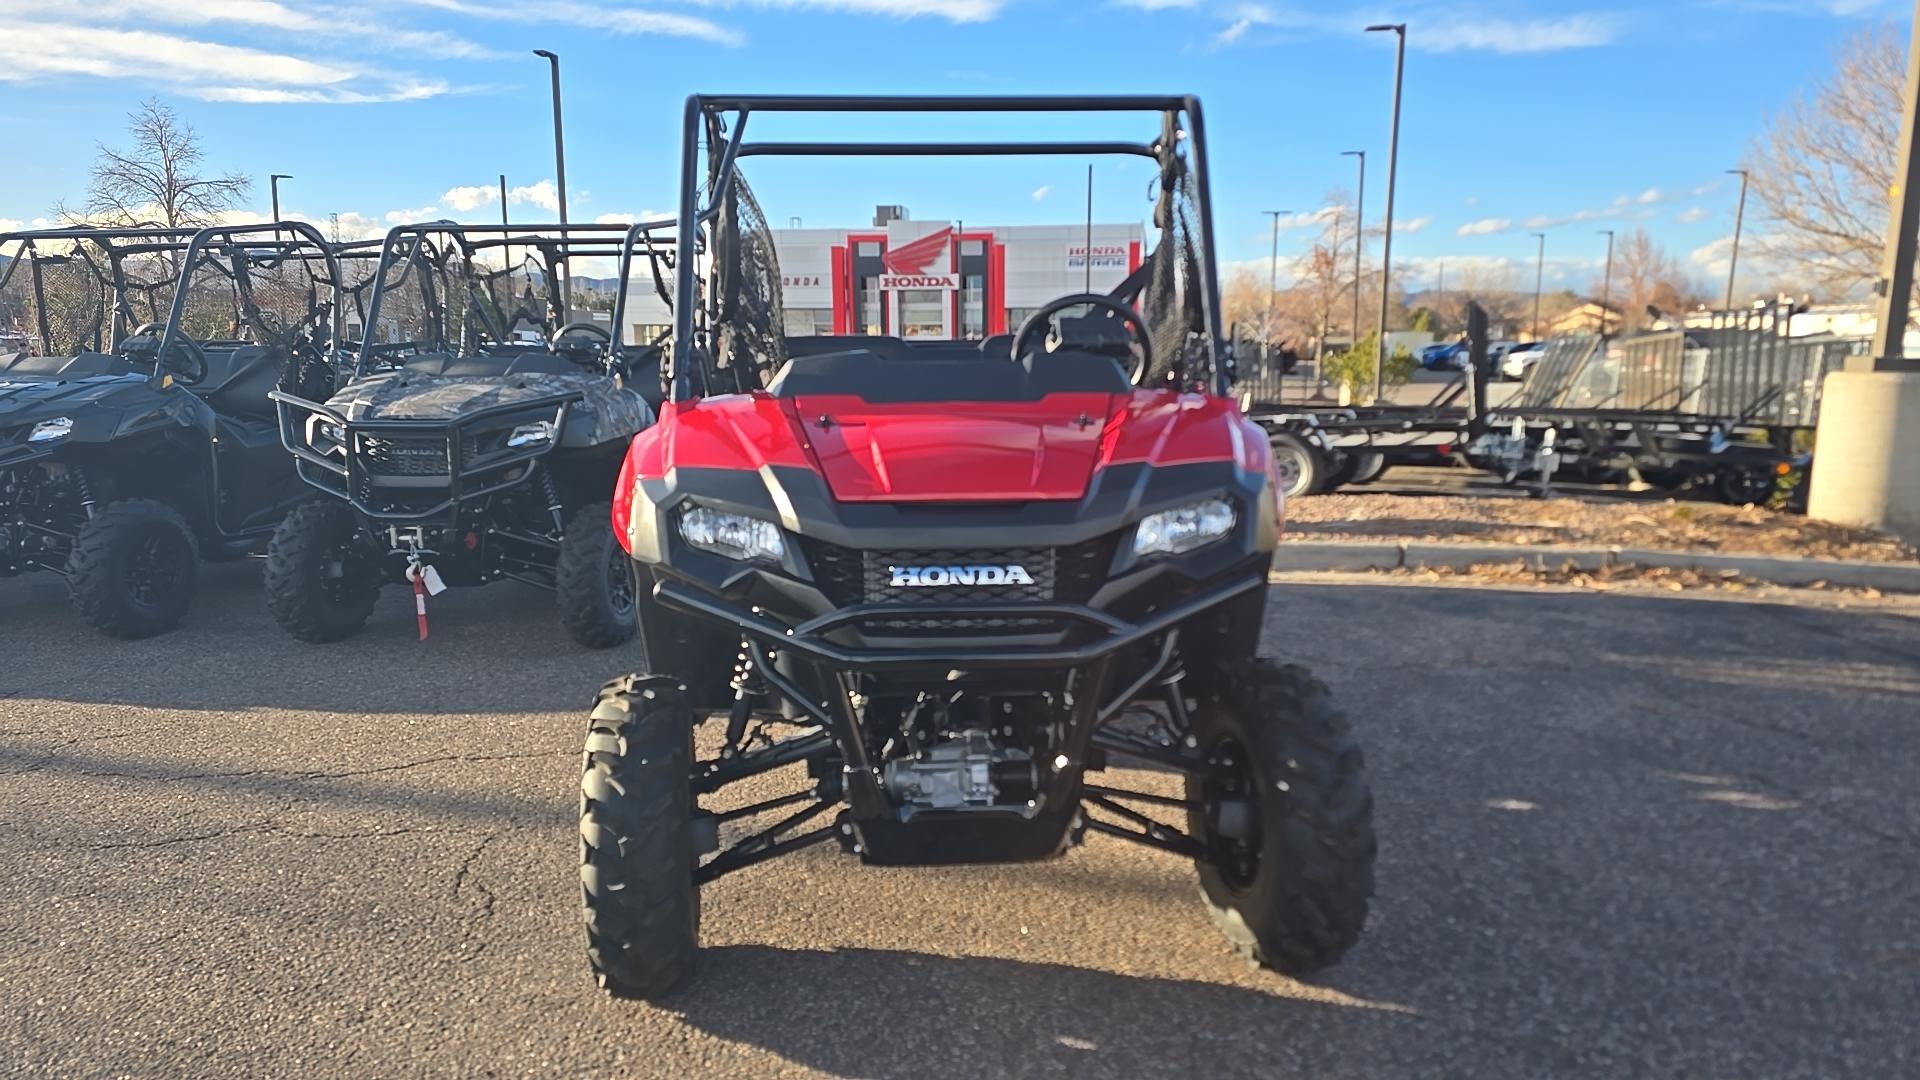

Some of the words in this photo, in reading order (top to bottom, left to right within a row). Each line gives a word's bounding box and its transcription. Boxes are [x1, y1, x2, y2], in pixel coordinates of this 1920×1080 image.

[783, 277, 819, 286] ONDA
[883, 277, 954, 287] HONDA
[889, 565, 1035, 586] HONDA
